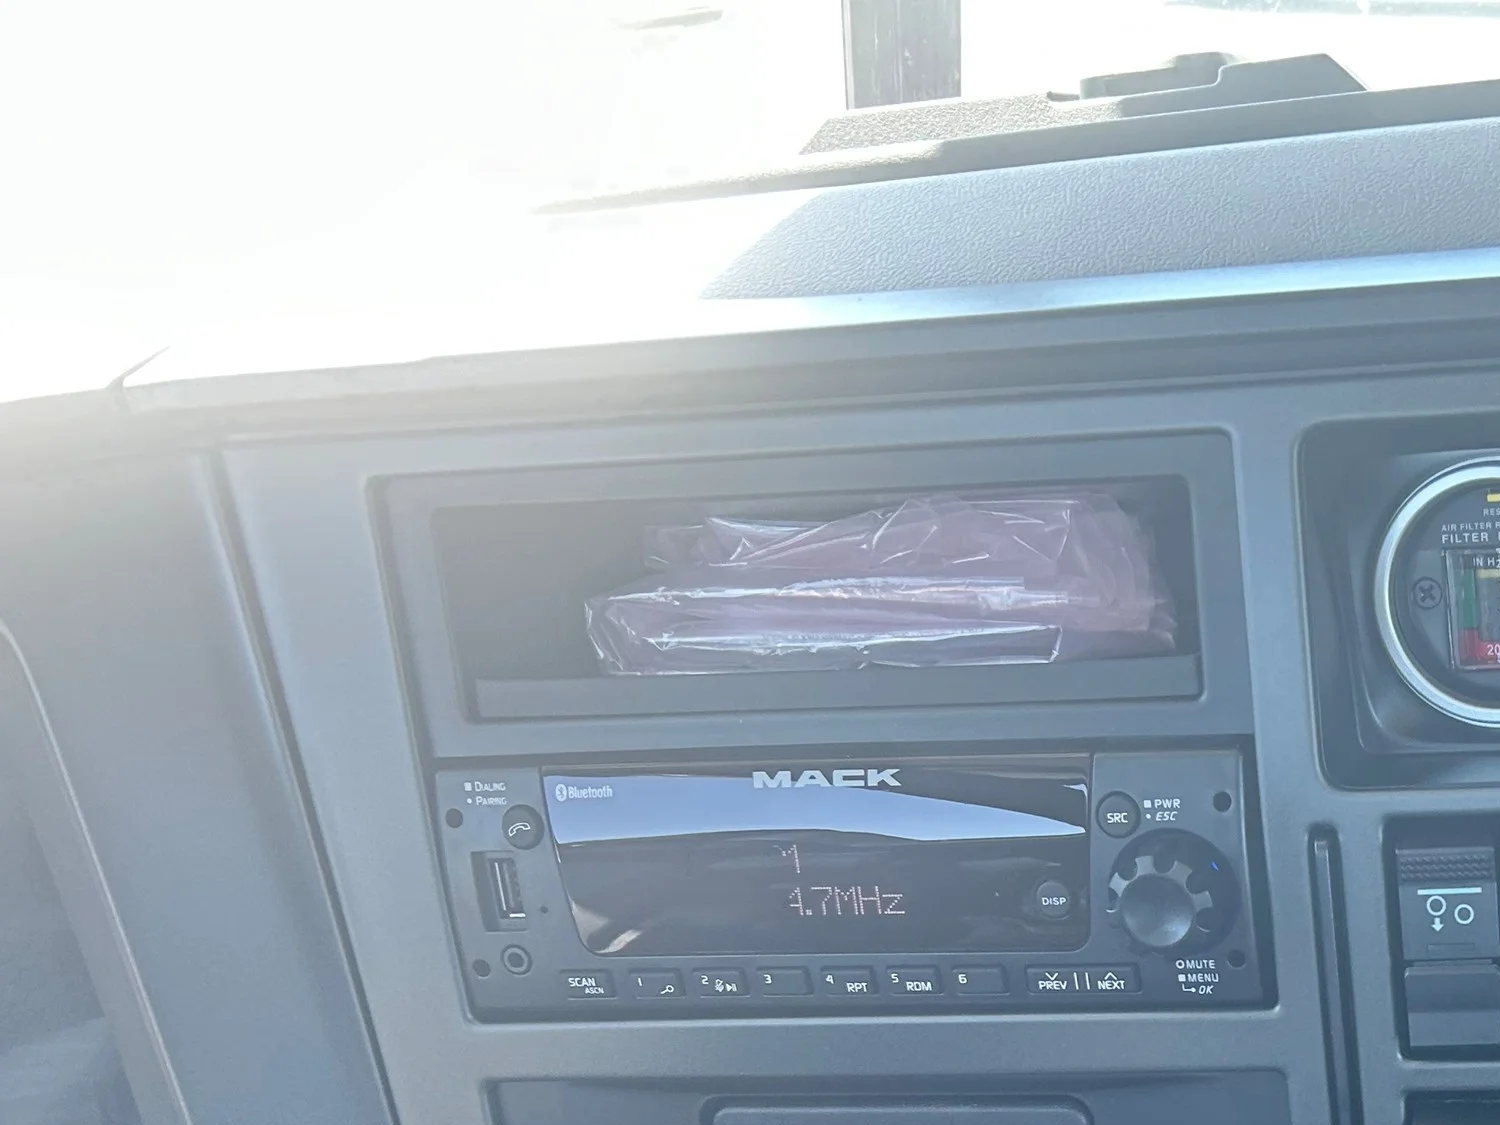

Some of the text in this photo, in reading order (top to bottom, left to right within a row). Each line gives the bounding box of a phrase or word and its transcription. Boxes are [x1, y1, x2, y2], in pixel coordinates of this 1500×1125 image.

[1441, 524, 1457, 532] AIR
[1460, 521, 1492, 531] FILTER
[1442, 532, 1489, 544] FILTER
[752, 768, 902, 789] MACK
[568, 785, 613, 799] Bluetooth
[1154, 798, 1181, 809] PWR
[1106, 812, 1129, 824] SRC
[1155, 811, 1178, 822] ESC
[1041, 896, 1067, 906] DISP
[1186, 959, 1216, 970] MUTE
[568, 977, 596, 987] SCAN
[701, 975, 709, 985] 2
[764, 974, 772, 984] 3
[825, 974, 834, 984] 4
[891, 973, 899, 983] 5
[958, 973, 967, 984] 6
[1187, 972, 1219, 983] MENU
[846, 982, 868, 993] RPT
[906, 981, 932, 992] RDM
[1038, 978, 1067, 990] PREV
[1098, 978, 1125, 990] NEXT
[1198, 984, 1213, 995] OK
